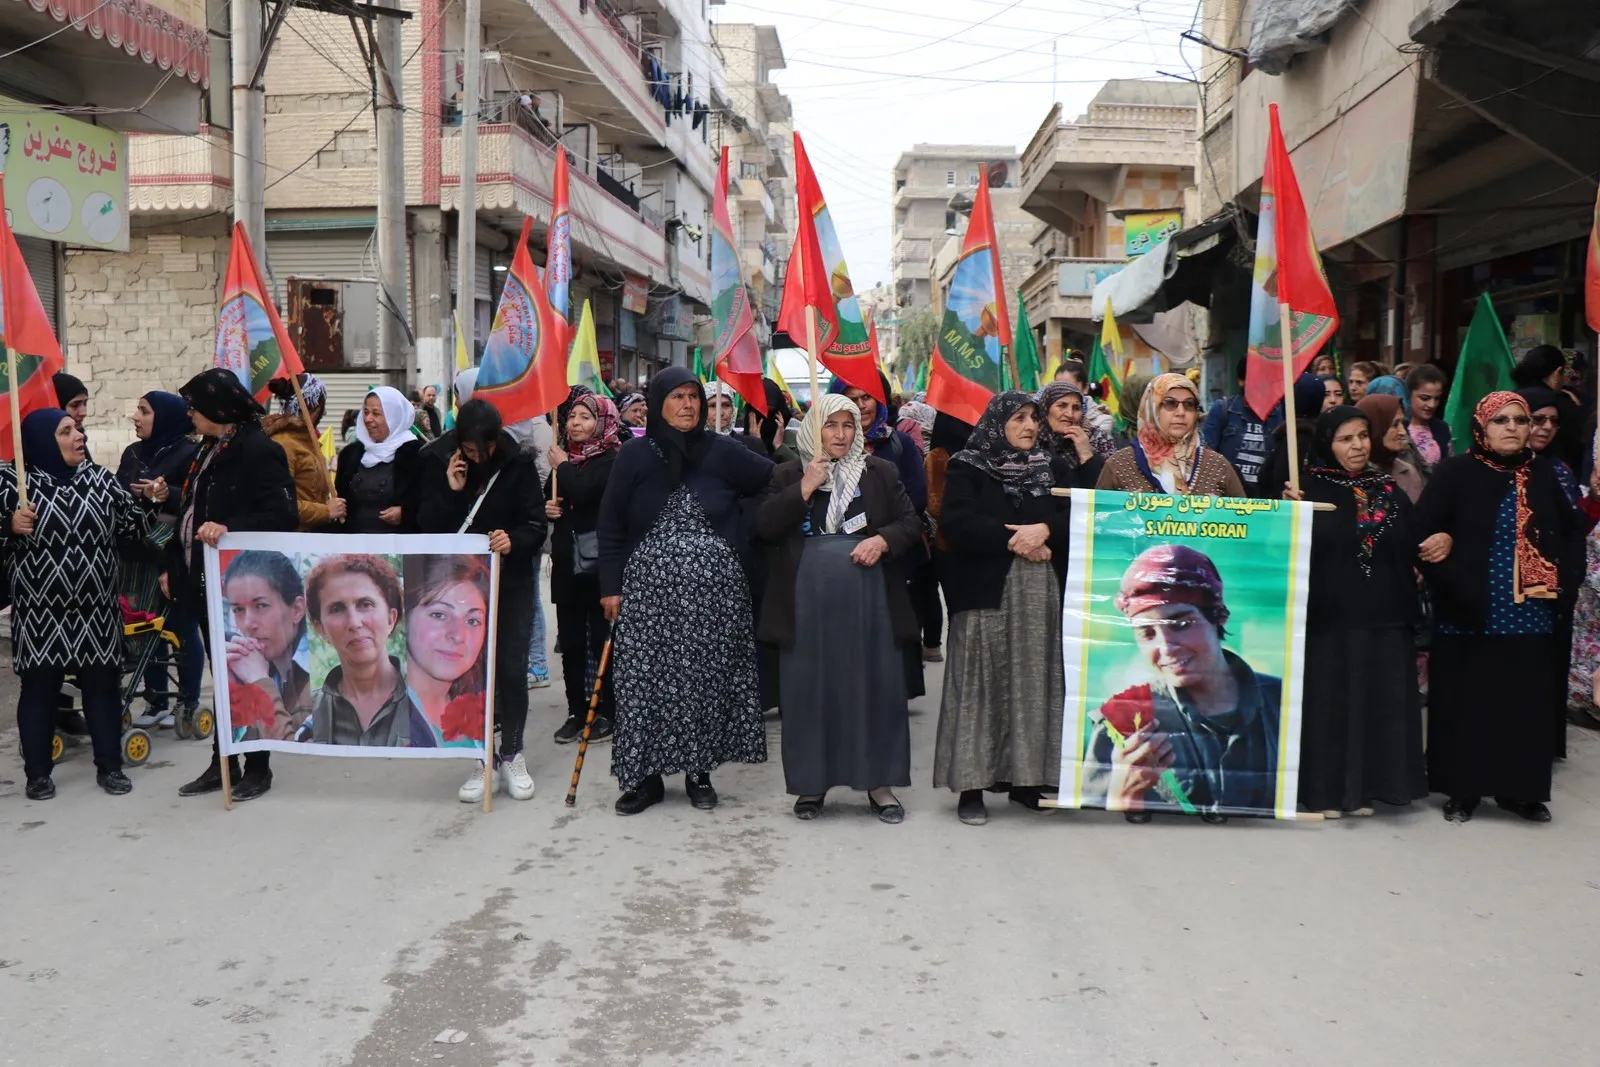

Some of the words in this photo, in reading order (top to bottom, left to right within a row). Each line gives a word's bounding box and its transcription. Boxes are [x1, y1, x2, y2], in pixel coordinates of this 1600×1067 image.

[23, 121, 73, 162] عفرين
[77, 142, 117, 176] فروج
[1199, 523, 1247, 539] SORAN
